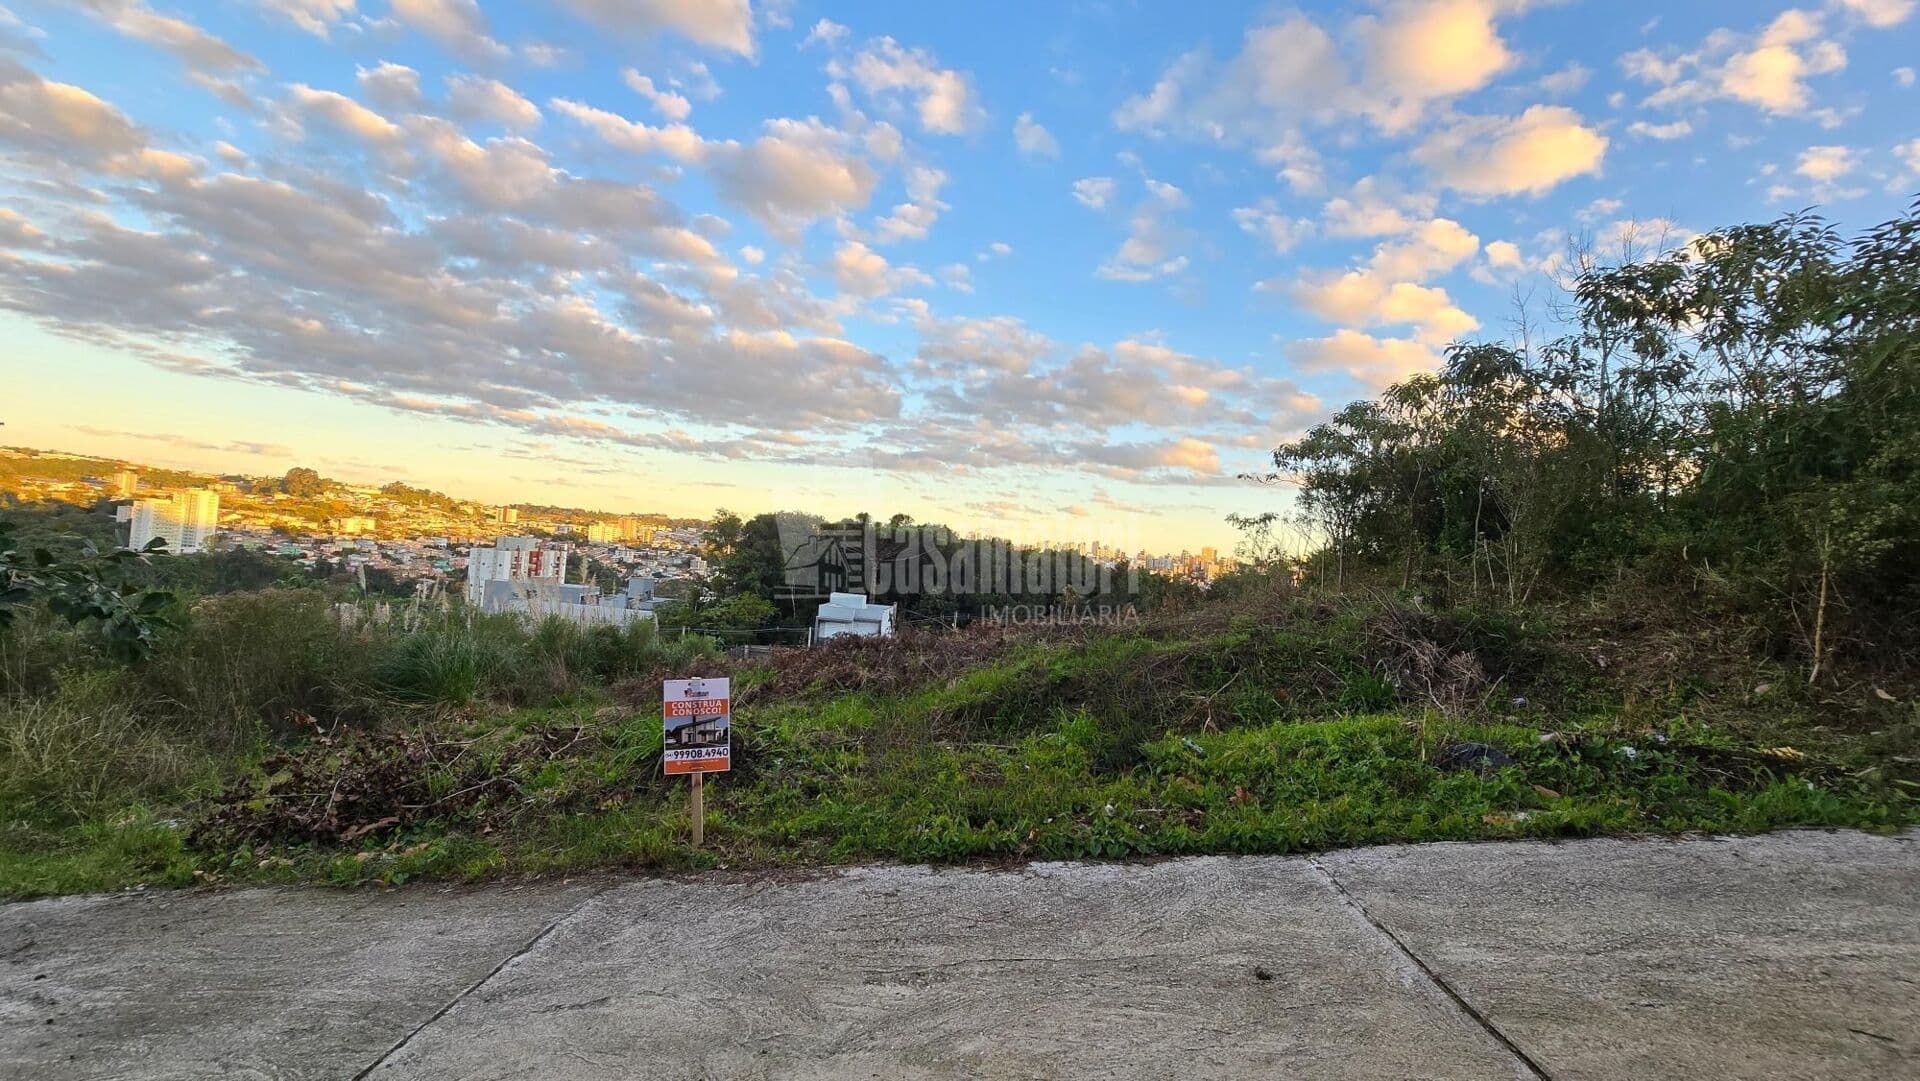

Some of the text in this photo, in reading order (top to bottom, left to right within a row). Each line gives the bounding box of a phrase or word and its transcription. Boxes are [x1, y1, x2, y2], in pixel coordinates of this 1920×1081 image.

[671, 700, 722, 709] CONSTRUA
[672, 707, 722, 716] CONOSCO!
[674, 747, 729, 759] 99908.4940
